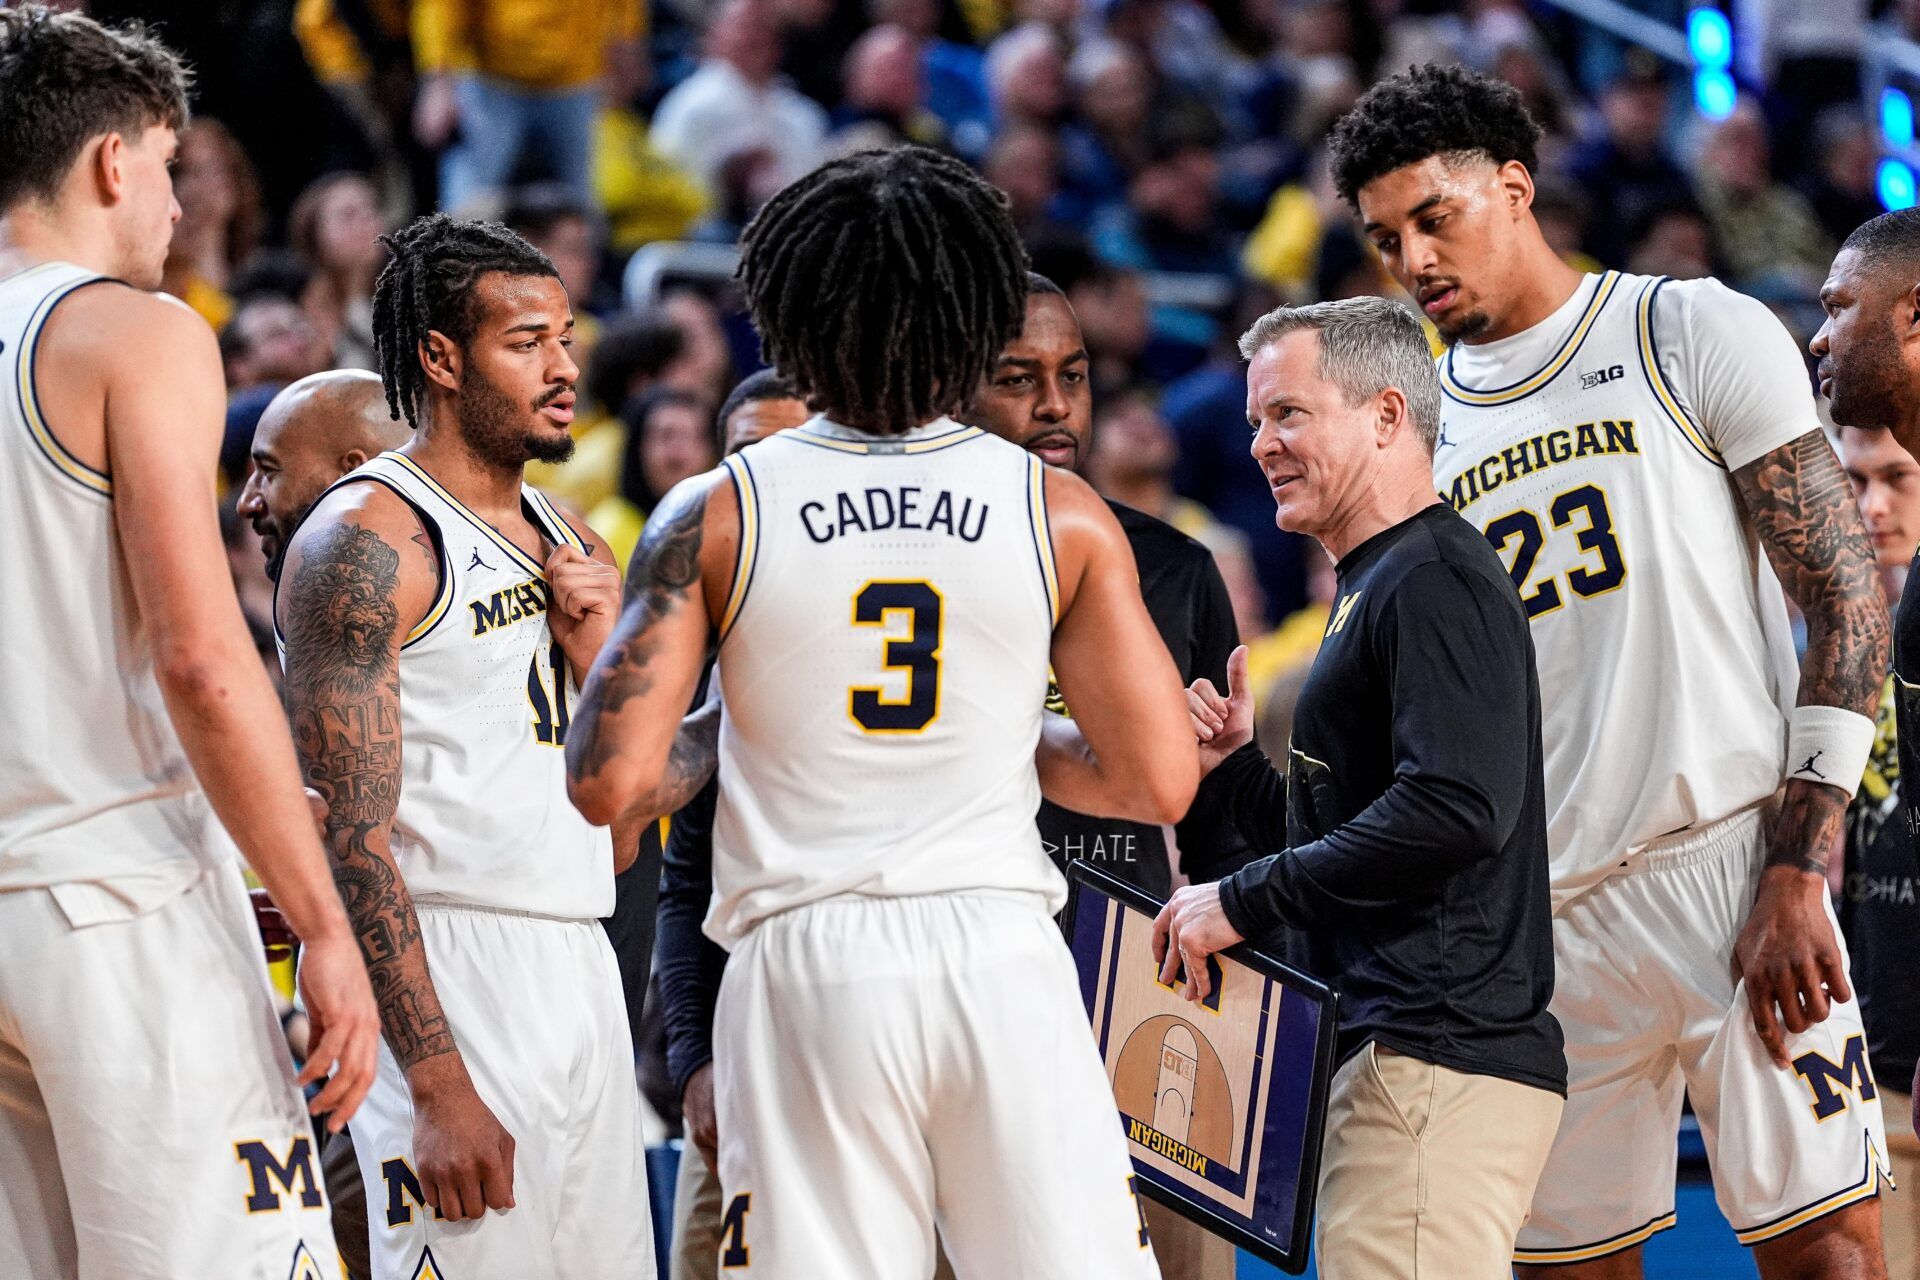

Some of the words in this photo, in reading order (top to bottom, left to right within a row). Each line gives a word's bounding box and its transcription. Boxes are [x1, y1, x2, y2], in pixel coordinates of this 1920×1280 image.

[1437, 418, 1642, 515] MICHIGAN
[799, 485, 990, 545] CADEAU
[1482, 481, 1629, 621] 23
[847, 576, 945, 736] 3
[1791, 1032, 1878, 1125] M
[233, 1136, 324, 1216] M
[1129, 1118, 1208, 1179] MICHIGAN
